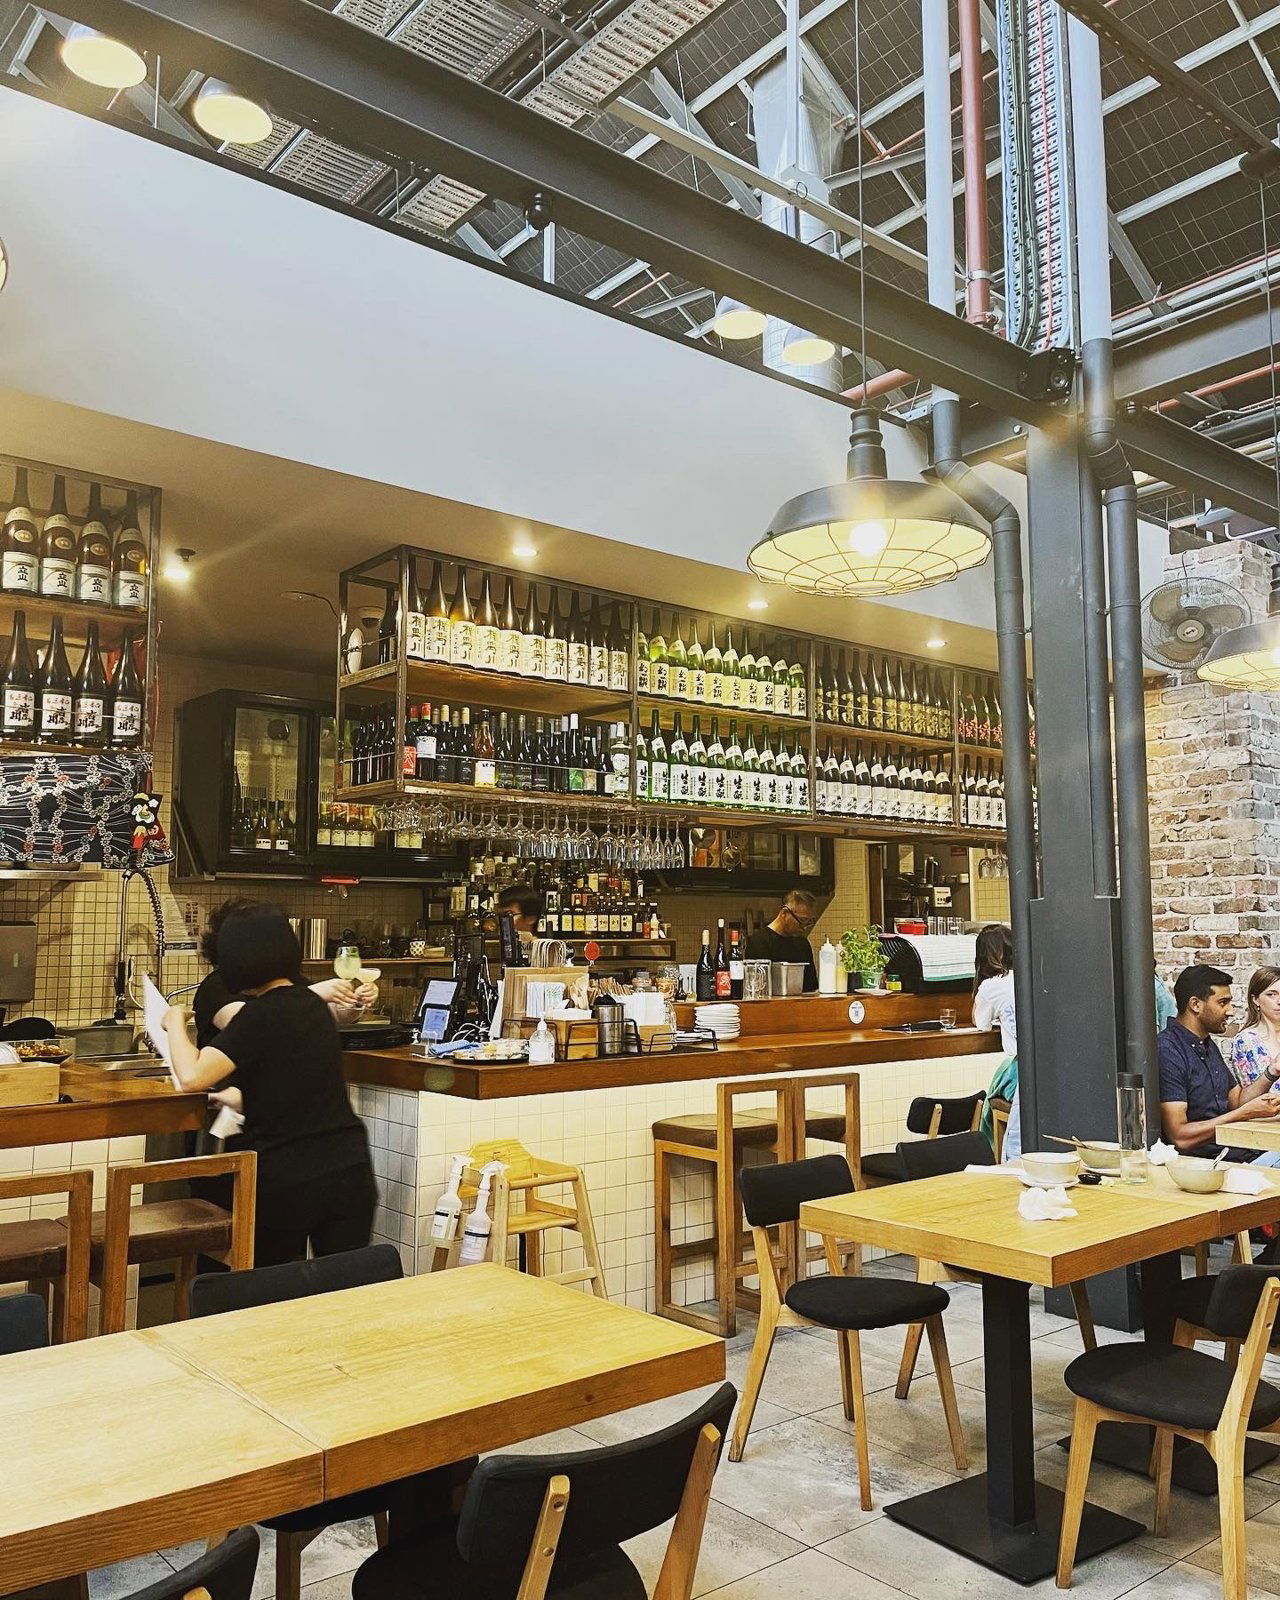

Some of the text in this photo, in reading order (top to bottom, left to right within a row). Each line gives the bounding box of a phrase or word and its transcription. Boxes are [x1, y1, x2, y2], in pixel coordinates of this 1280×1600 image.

[17, 566, 28, 582] 立山
[57, 572, 68, 588] 立山
[92, 578, 103, 593] 立山
[129, 584, 140, 599] 立山
